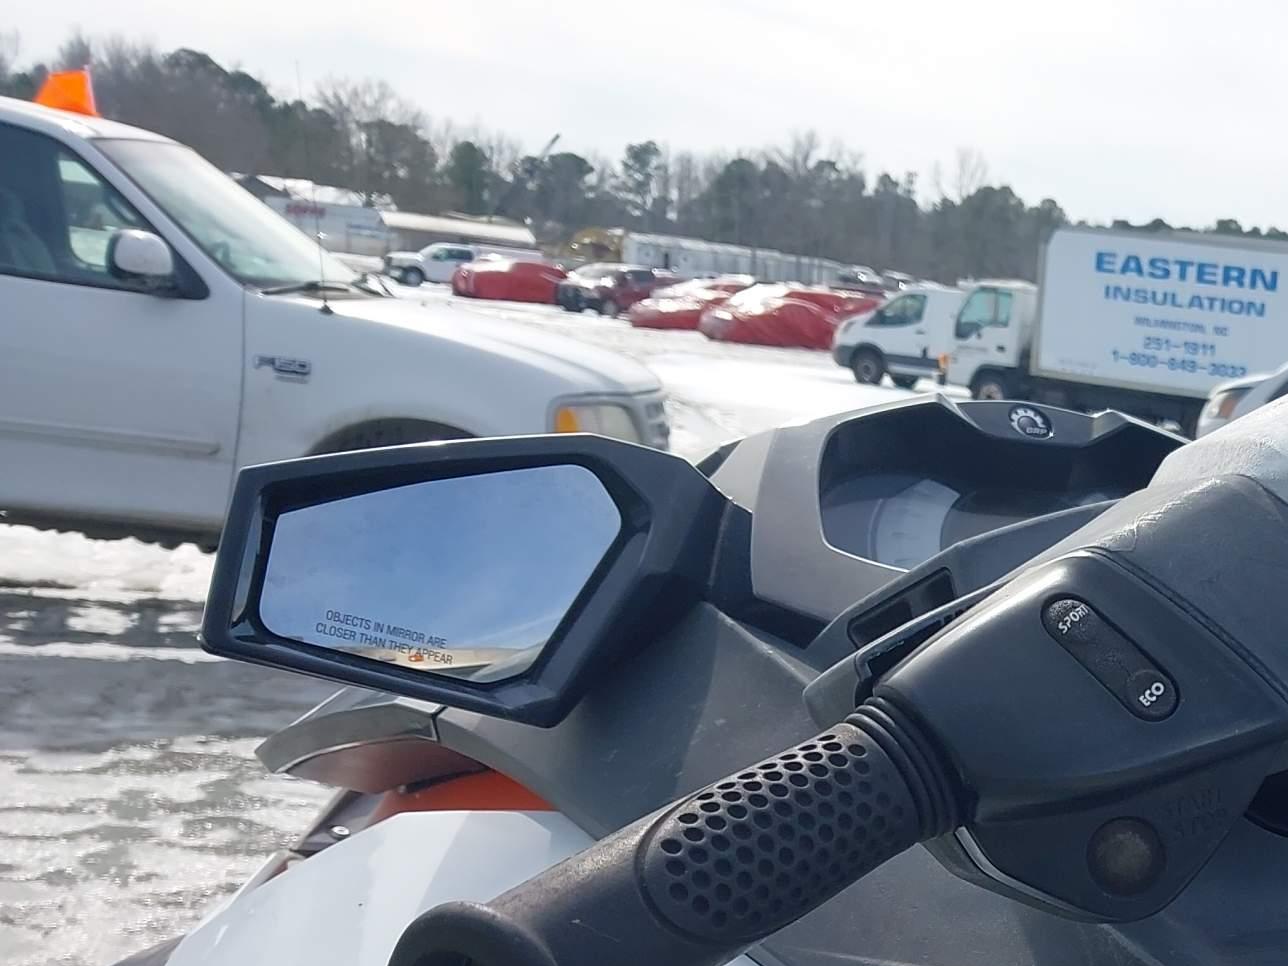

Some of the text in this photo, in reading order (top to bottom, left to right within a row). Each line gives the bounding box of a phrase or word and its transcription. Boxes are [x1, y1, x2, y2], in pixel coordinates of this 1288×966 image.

[1094, 251, 1279, 292] EASTERN
[1104, 285, 1266, 317] INSULATION
[326, 609, 447, 649] OBJECTS IN MIRROR ARE
[1058, 604, 1090, 634] SPORT
[315, 622, 454, 665] CLOSER THAN THEY APPEAR
[1139, 682, 1165, 707] ECO
